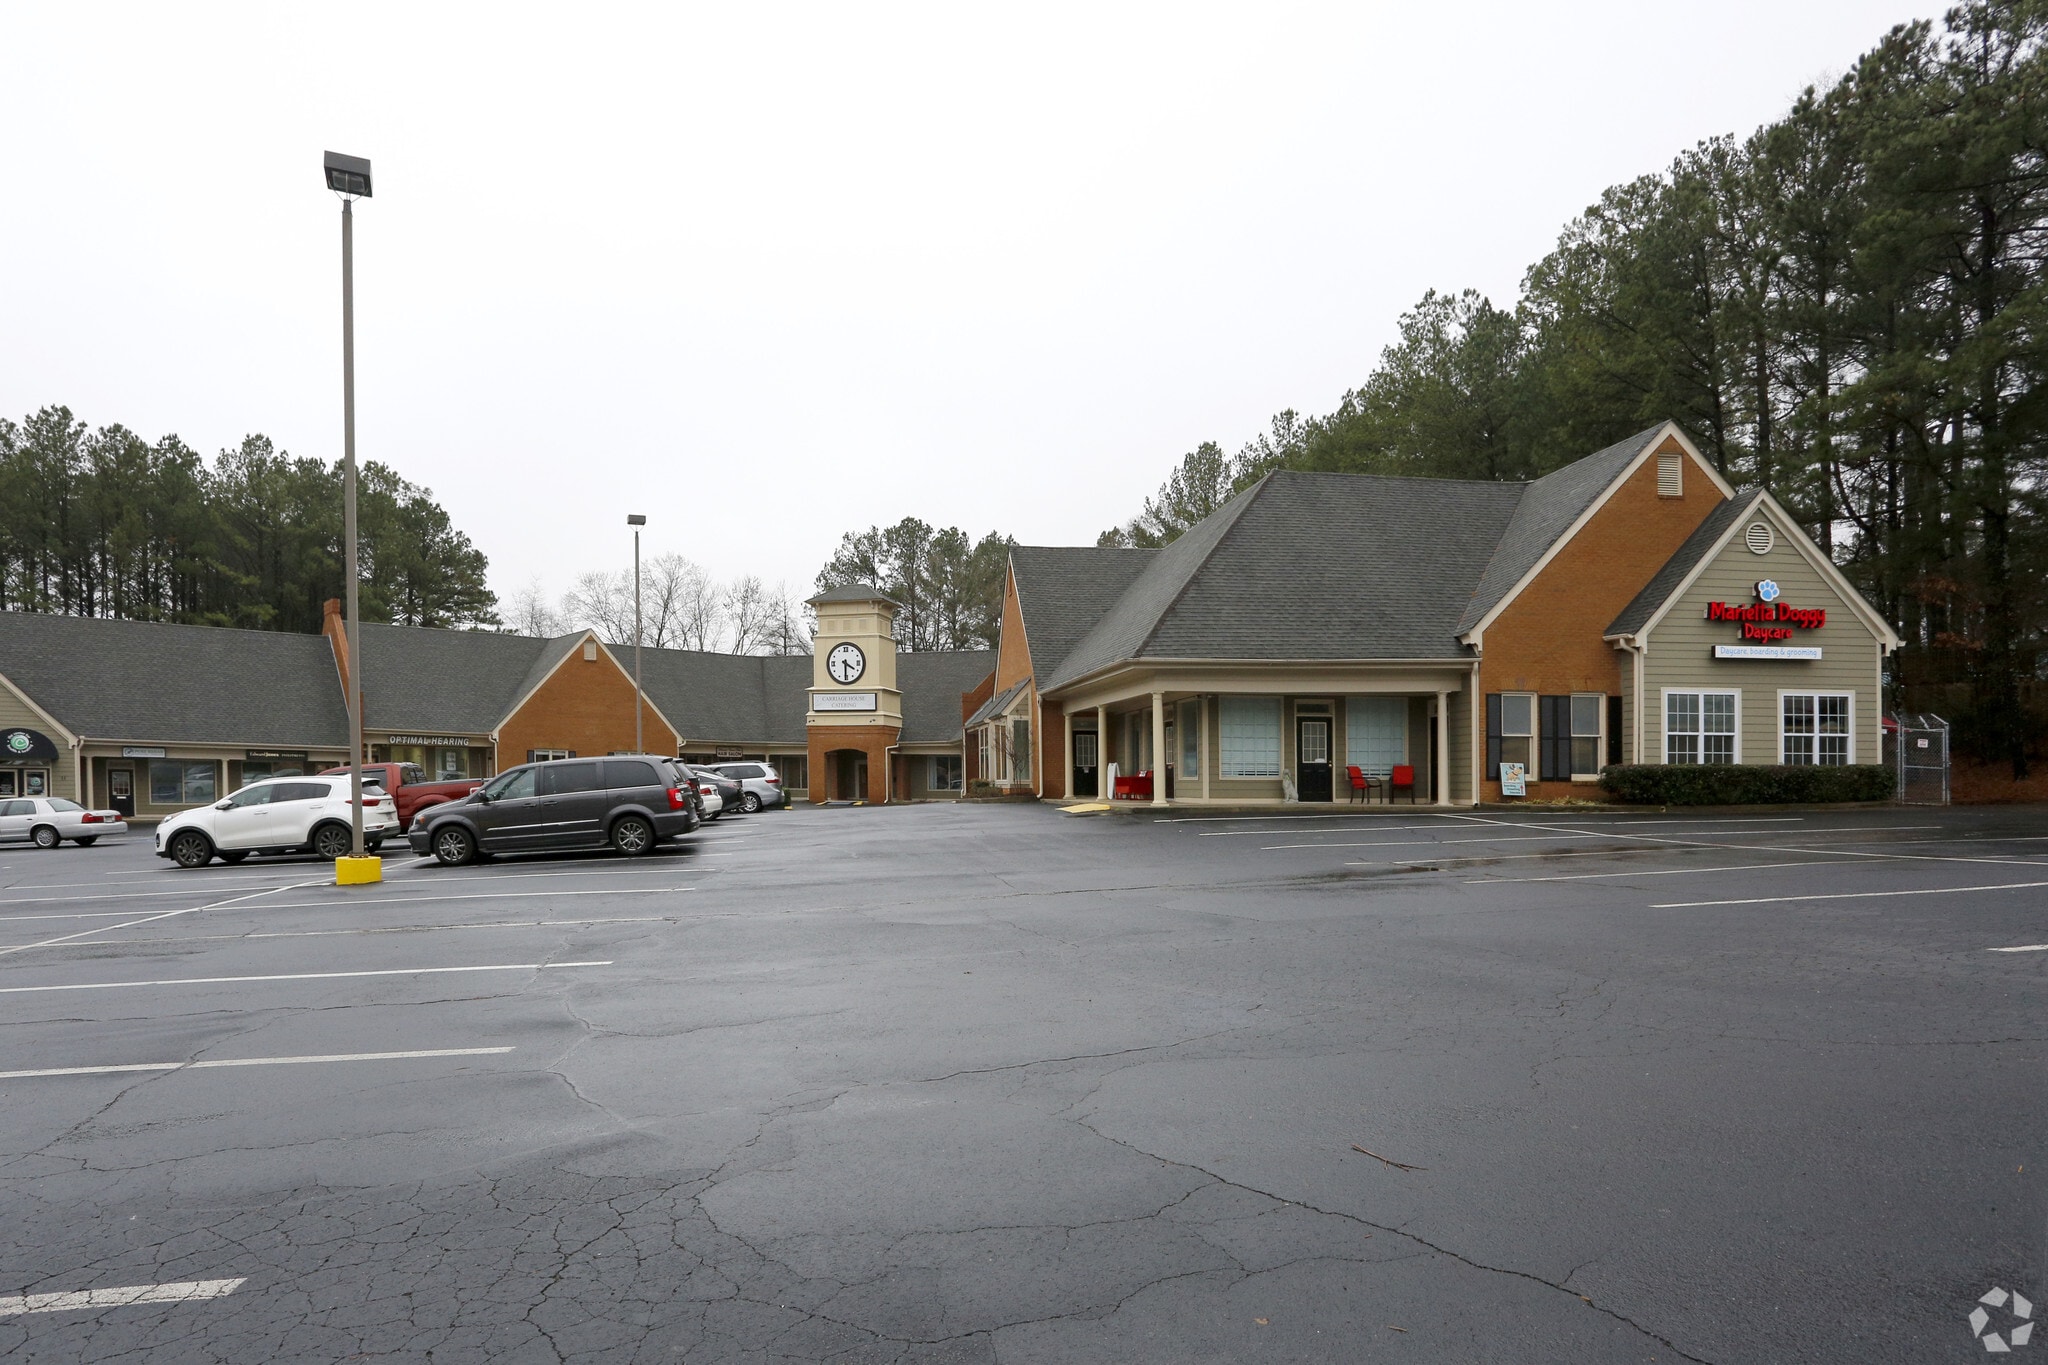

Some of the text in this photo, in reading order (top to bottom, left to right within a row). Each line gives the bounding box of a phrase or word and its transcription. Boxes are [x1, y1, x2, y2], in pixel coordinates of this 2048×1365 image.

[1710, 601, 1826, 628] Marietta Doggy
[1744, 622, 1793, 644] Daycare
[1750, 647, 1778, 657] boarding
[1780, 648, 1785, 656] &
[1786, 649, 1817, 658] grooming
[389, 735, 470, 746] OPTIMAL HEARING
